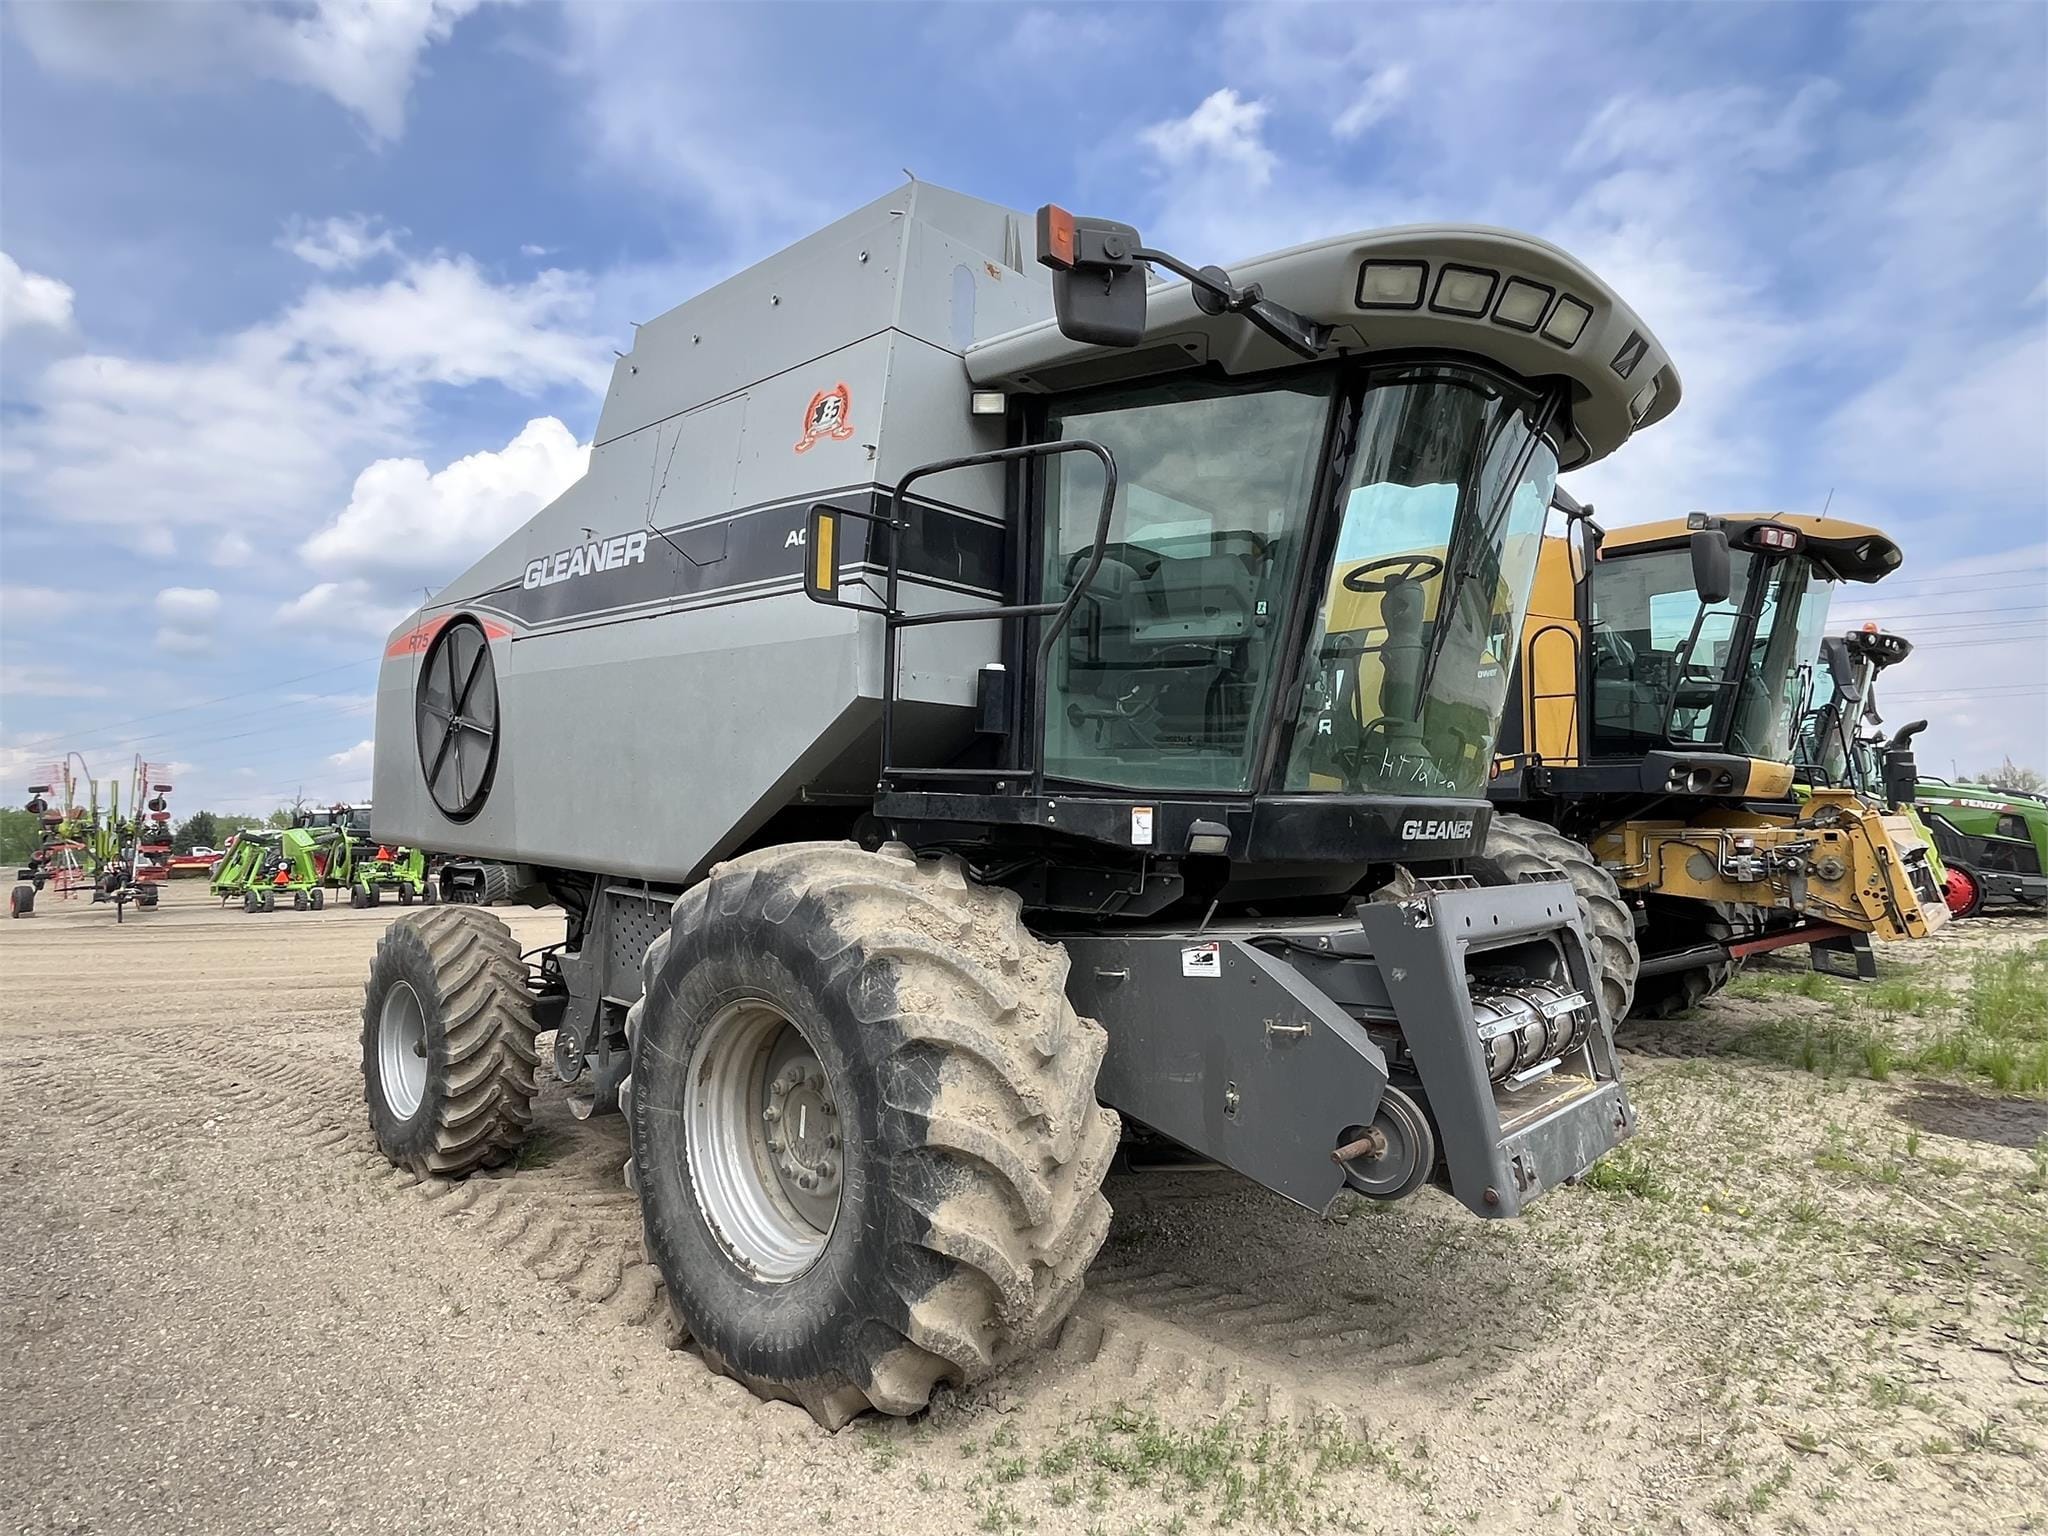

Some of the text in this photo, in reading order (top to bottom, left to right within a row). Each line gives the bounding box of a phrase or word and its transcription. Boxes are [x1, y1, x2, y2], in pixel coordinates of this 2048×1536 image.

[522, 530, 648, 590] GLEANER
[1960, 798, 2008, 811] FENDT
[1401, 820, 1473, 840] GLEANER
